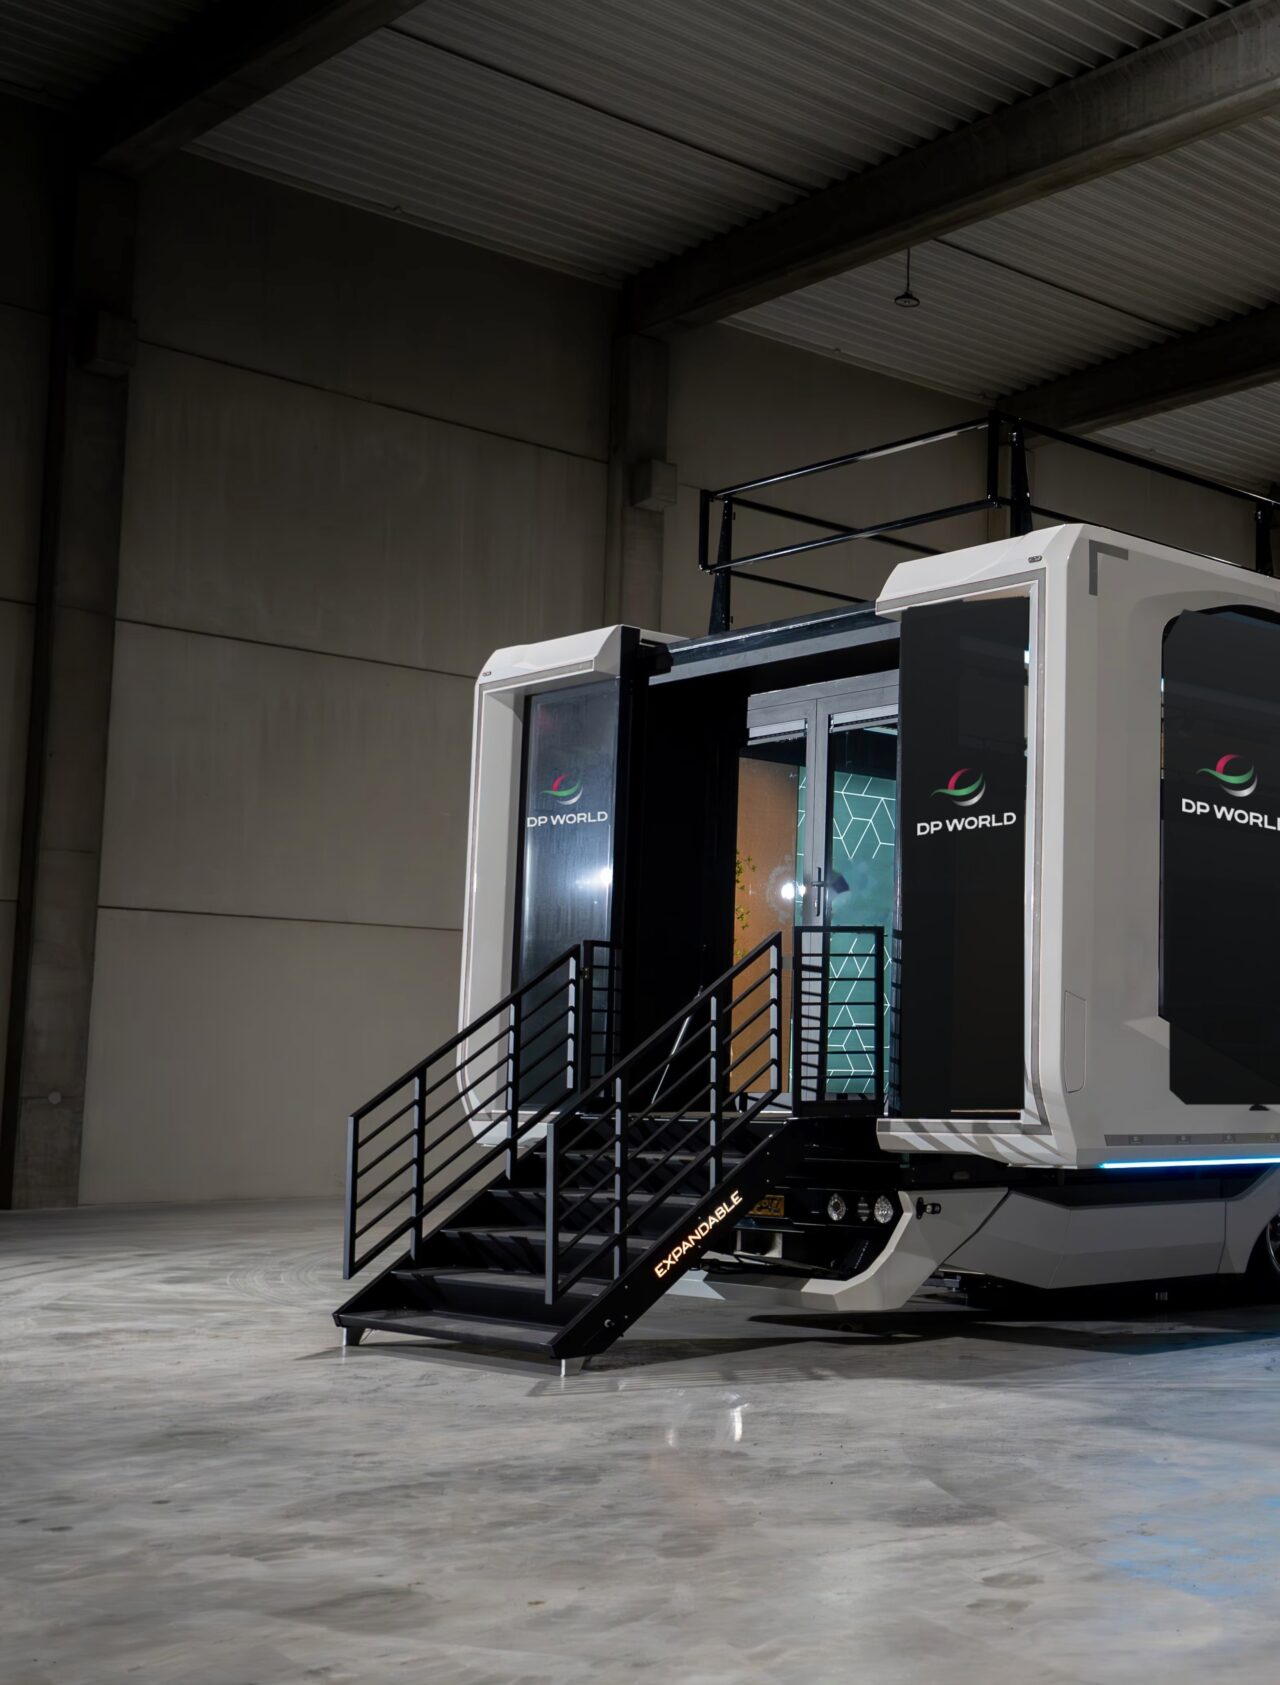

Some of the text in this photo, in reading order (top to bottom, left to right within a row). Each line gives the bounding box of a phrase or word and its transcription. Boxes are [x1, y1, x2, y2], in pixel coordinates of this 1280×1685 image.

[1181, 798, 1211, 815] DP
[526, 811, 609, 828] DP WORLD
[916, 812, 1017, 836] DP WORLD
[654, 1190, 743, 1279] EXPANDABLE
